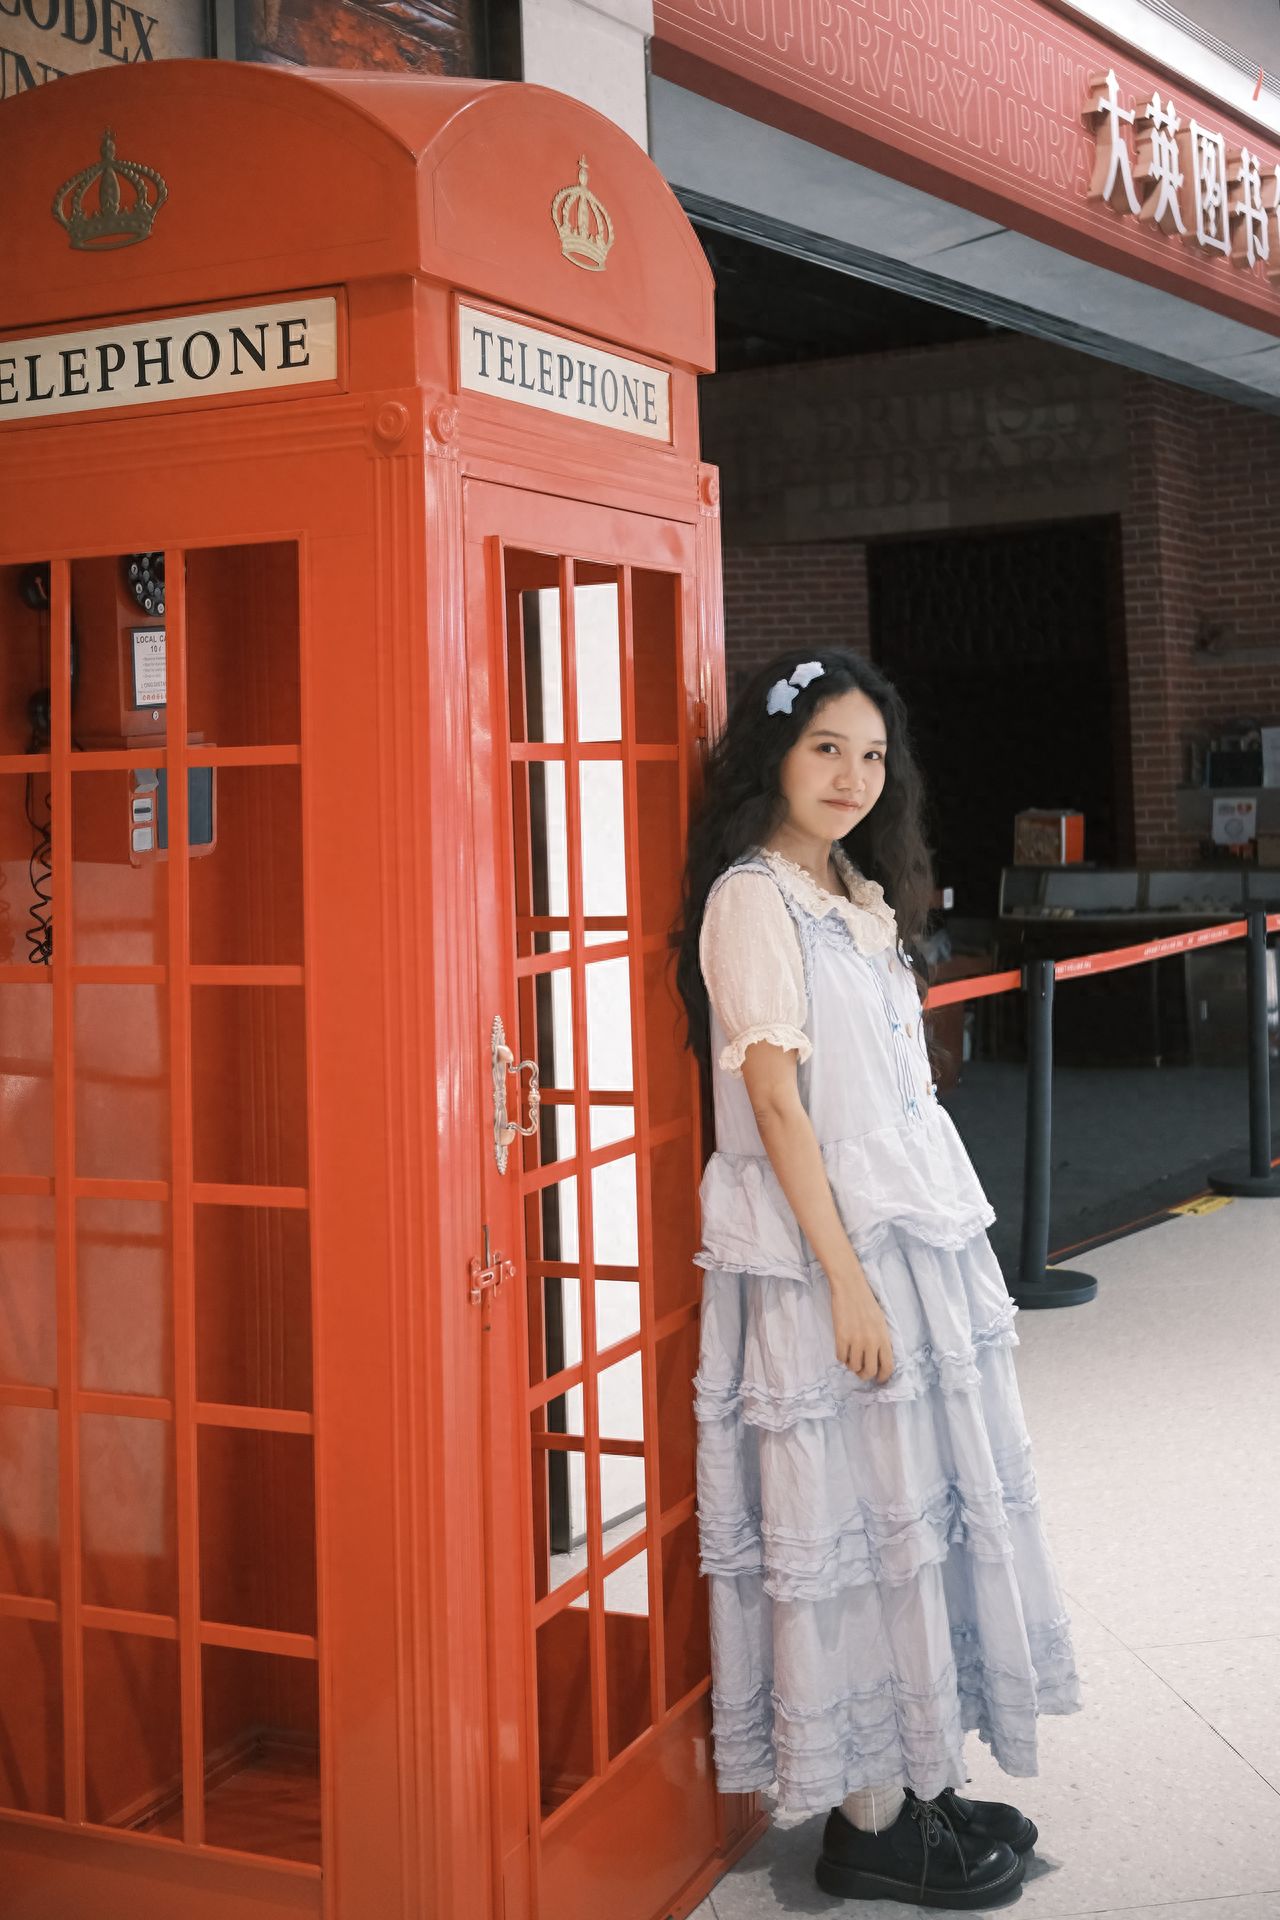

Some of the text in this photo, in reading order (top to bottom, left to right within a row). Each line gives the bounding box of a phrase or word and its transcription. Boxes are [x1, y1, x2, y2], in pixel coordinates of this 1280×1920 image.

[0, 0, 158, 63] ODEX
[473, 326, 657, 425] TELEPHONE
[136, 635, 157, 644] LOCAL
